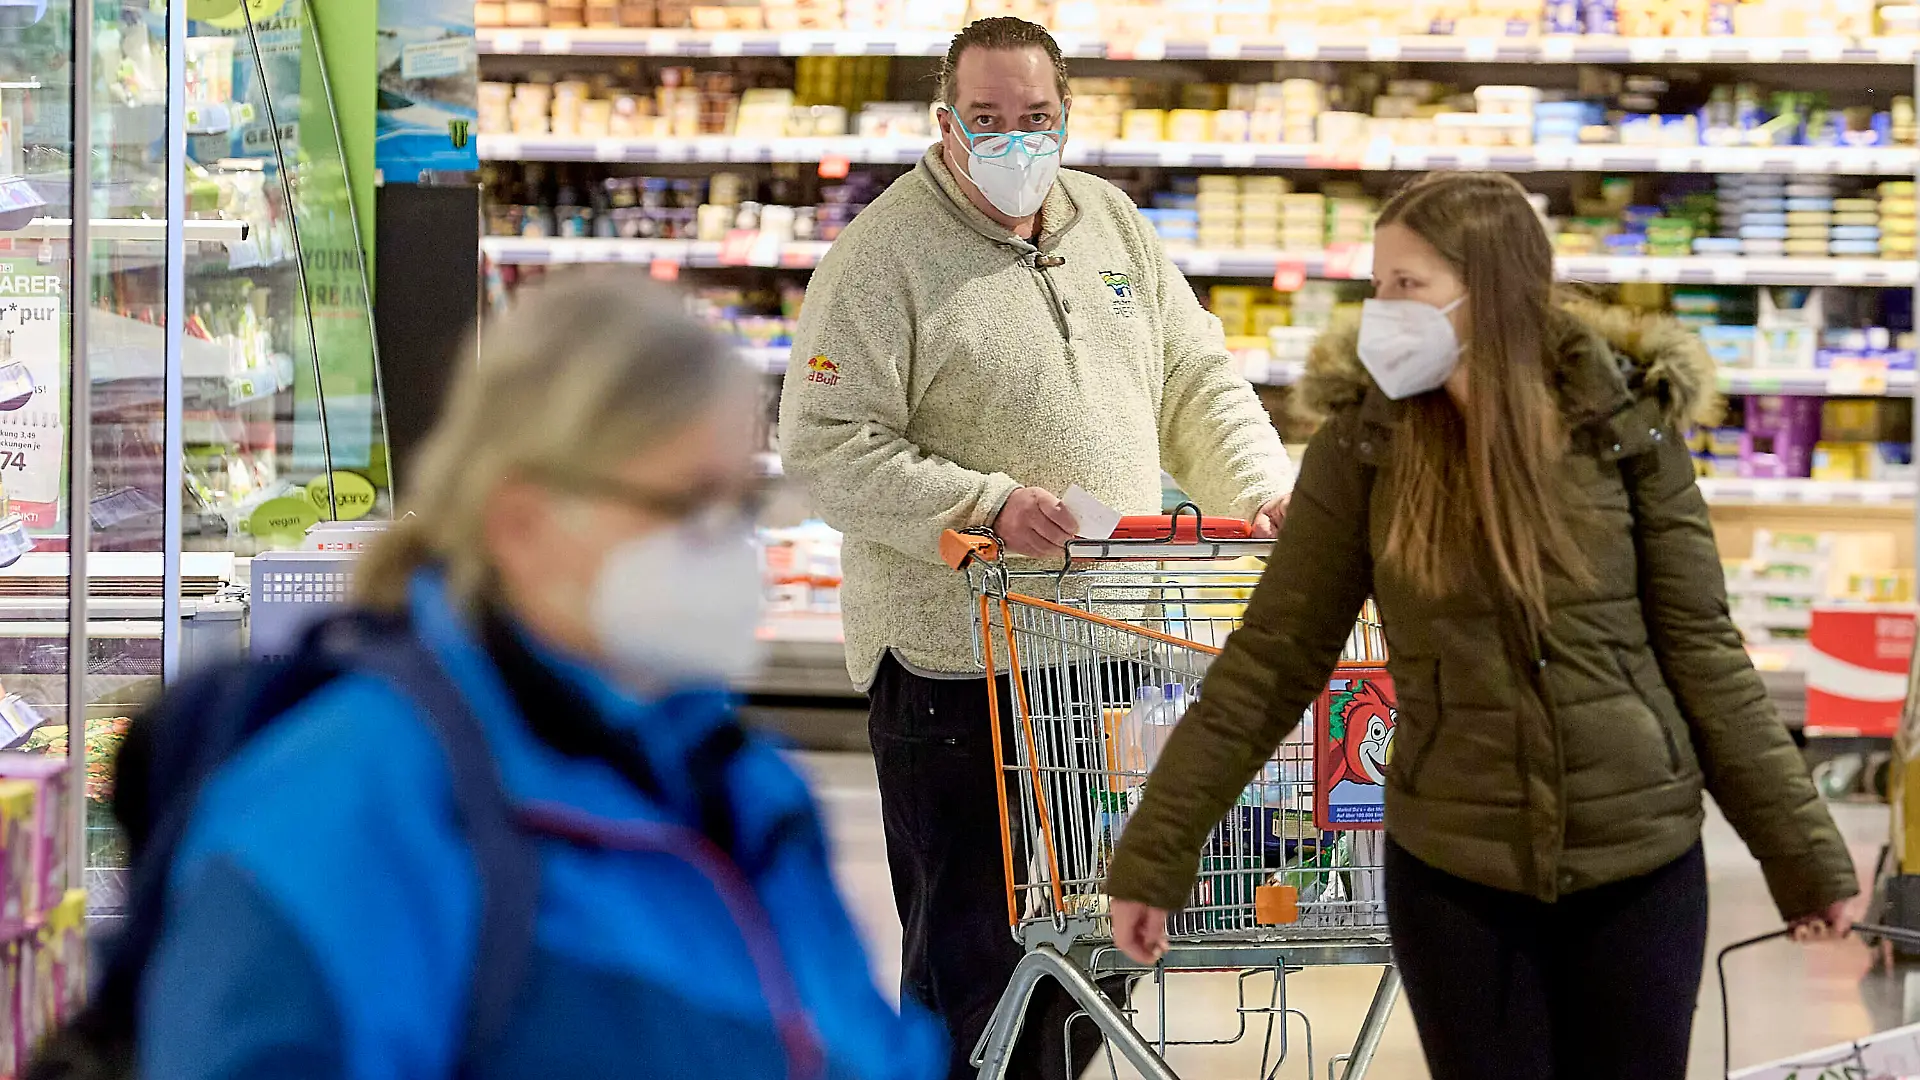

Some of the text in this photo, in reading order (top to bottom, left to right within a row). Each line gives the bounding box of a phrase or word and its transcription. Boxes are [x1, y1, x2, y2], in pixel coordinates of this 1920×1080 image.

[0, 275, 62, 293] ARER
[20, 307, 55, 325] pur
[816, 372, 838, 386] Bull
[269, 515, 300, 529] vegan
